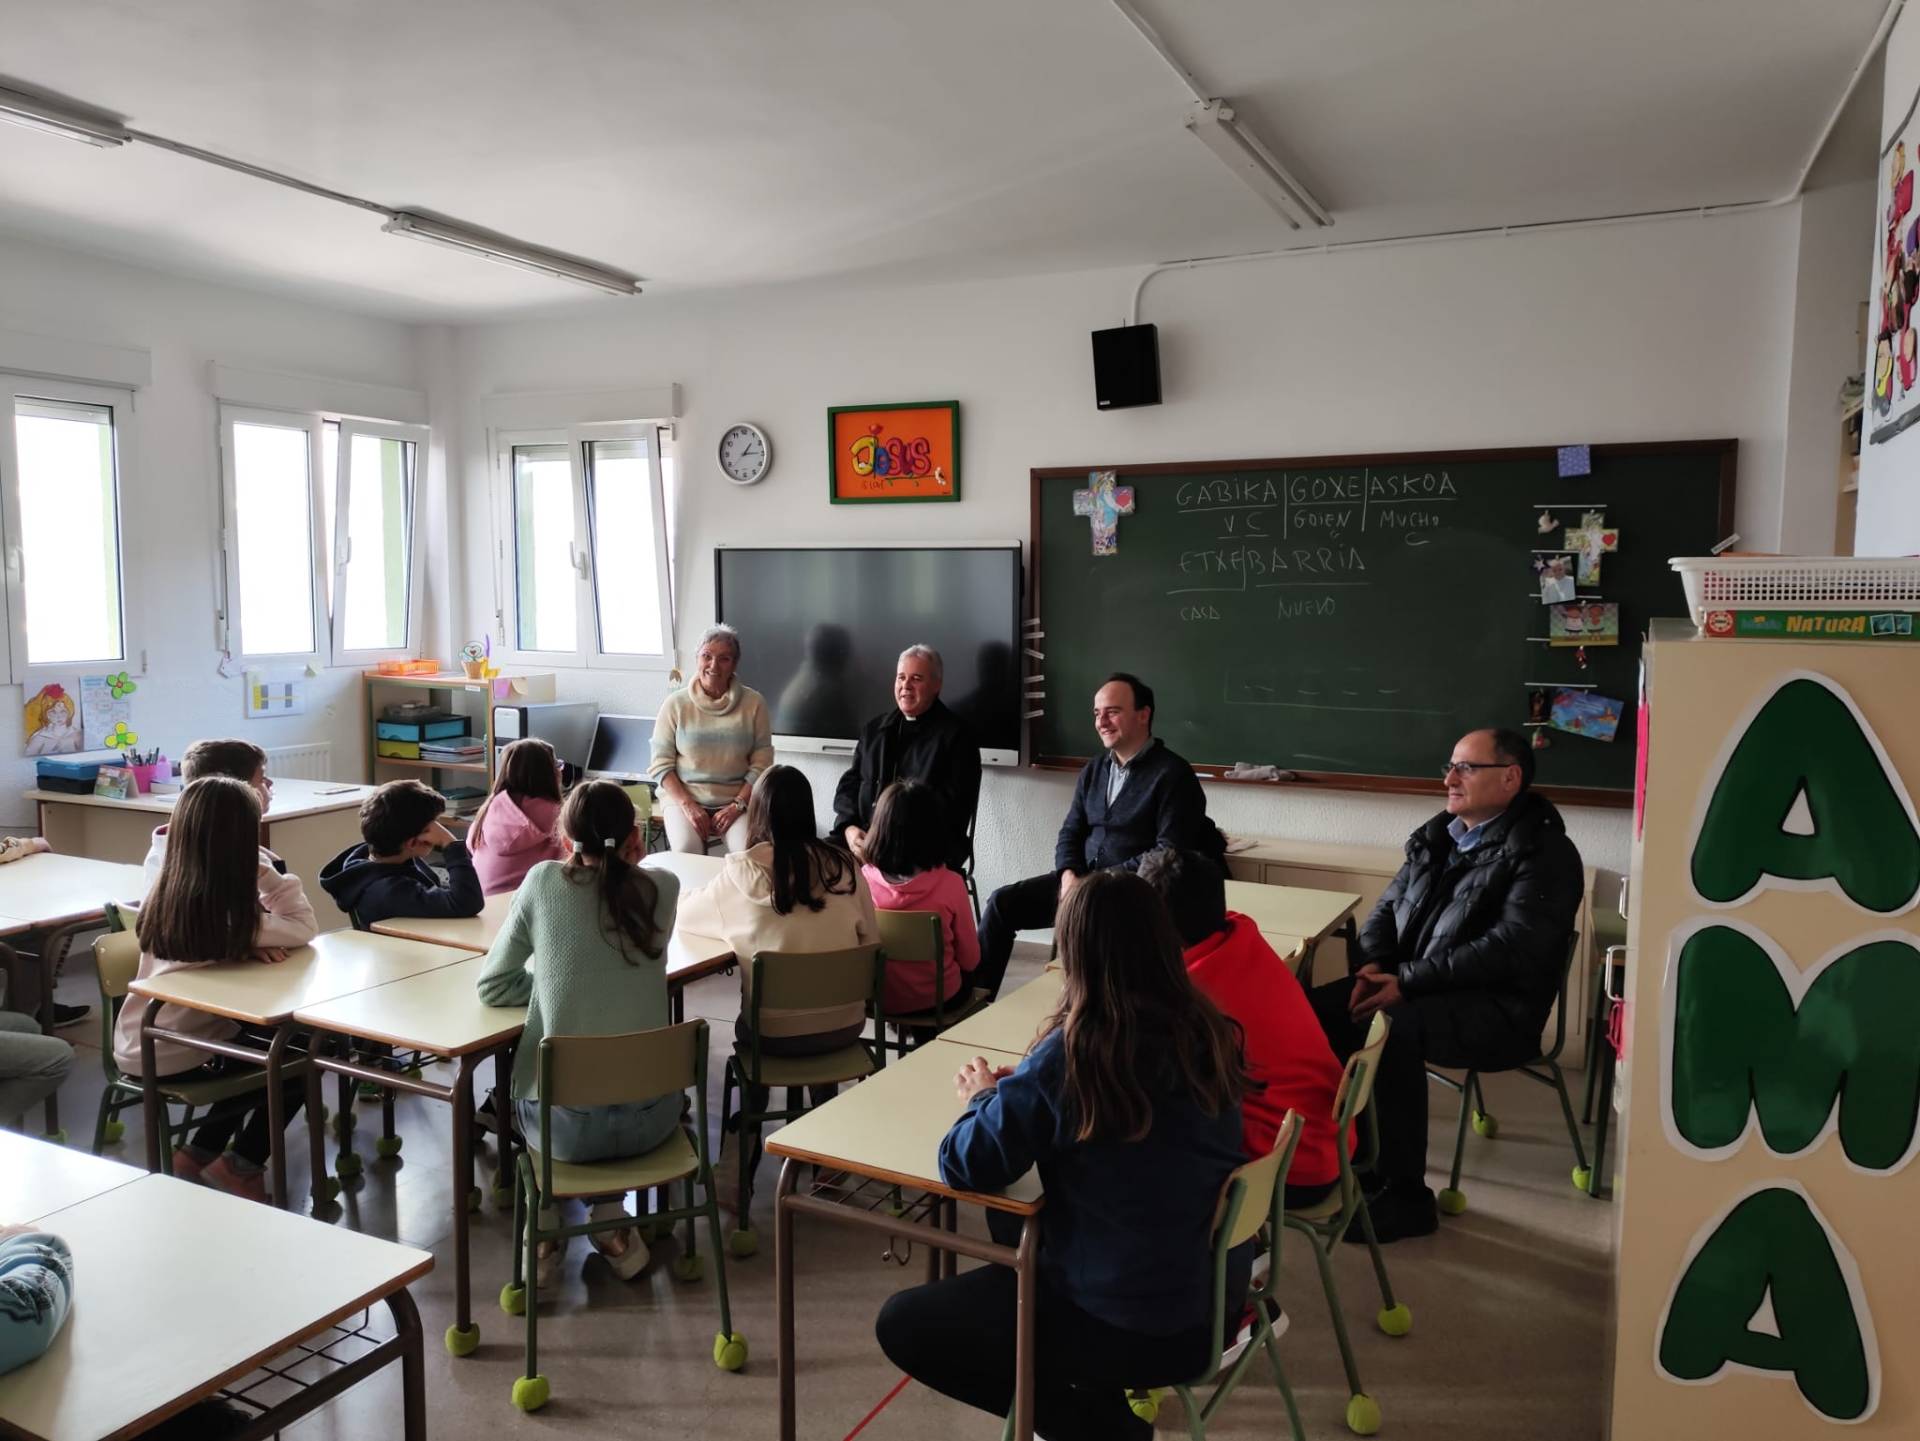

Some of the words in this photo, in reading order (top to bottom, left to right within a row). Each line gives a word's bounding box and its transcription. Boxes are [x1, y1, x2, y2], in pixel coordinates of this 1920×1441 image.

[1176, 478, 1277, 505] GABIKA
[1290, 474, 1362, 503] GOXE
[1370, 471, 1458, 497] ASKOA
[1179, 551, 1244, 574] ETXE
[1249, 543, 1367, 575] BARRIA
[1277, 597, 1337, 620] NUEVO
[1787, 615, 1866, 633] NATURA
